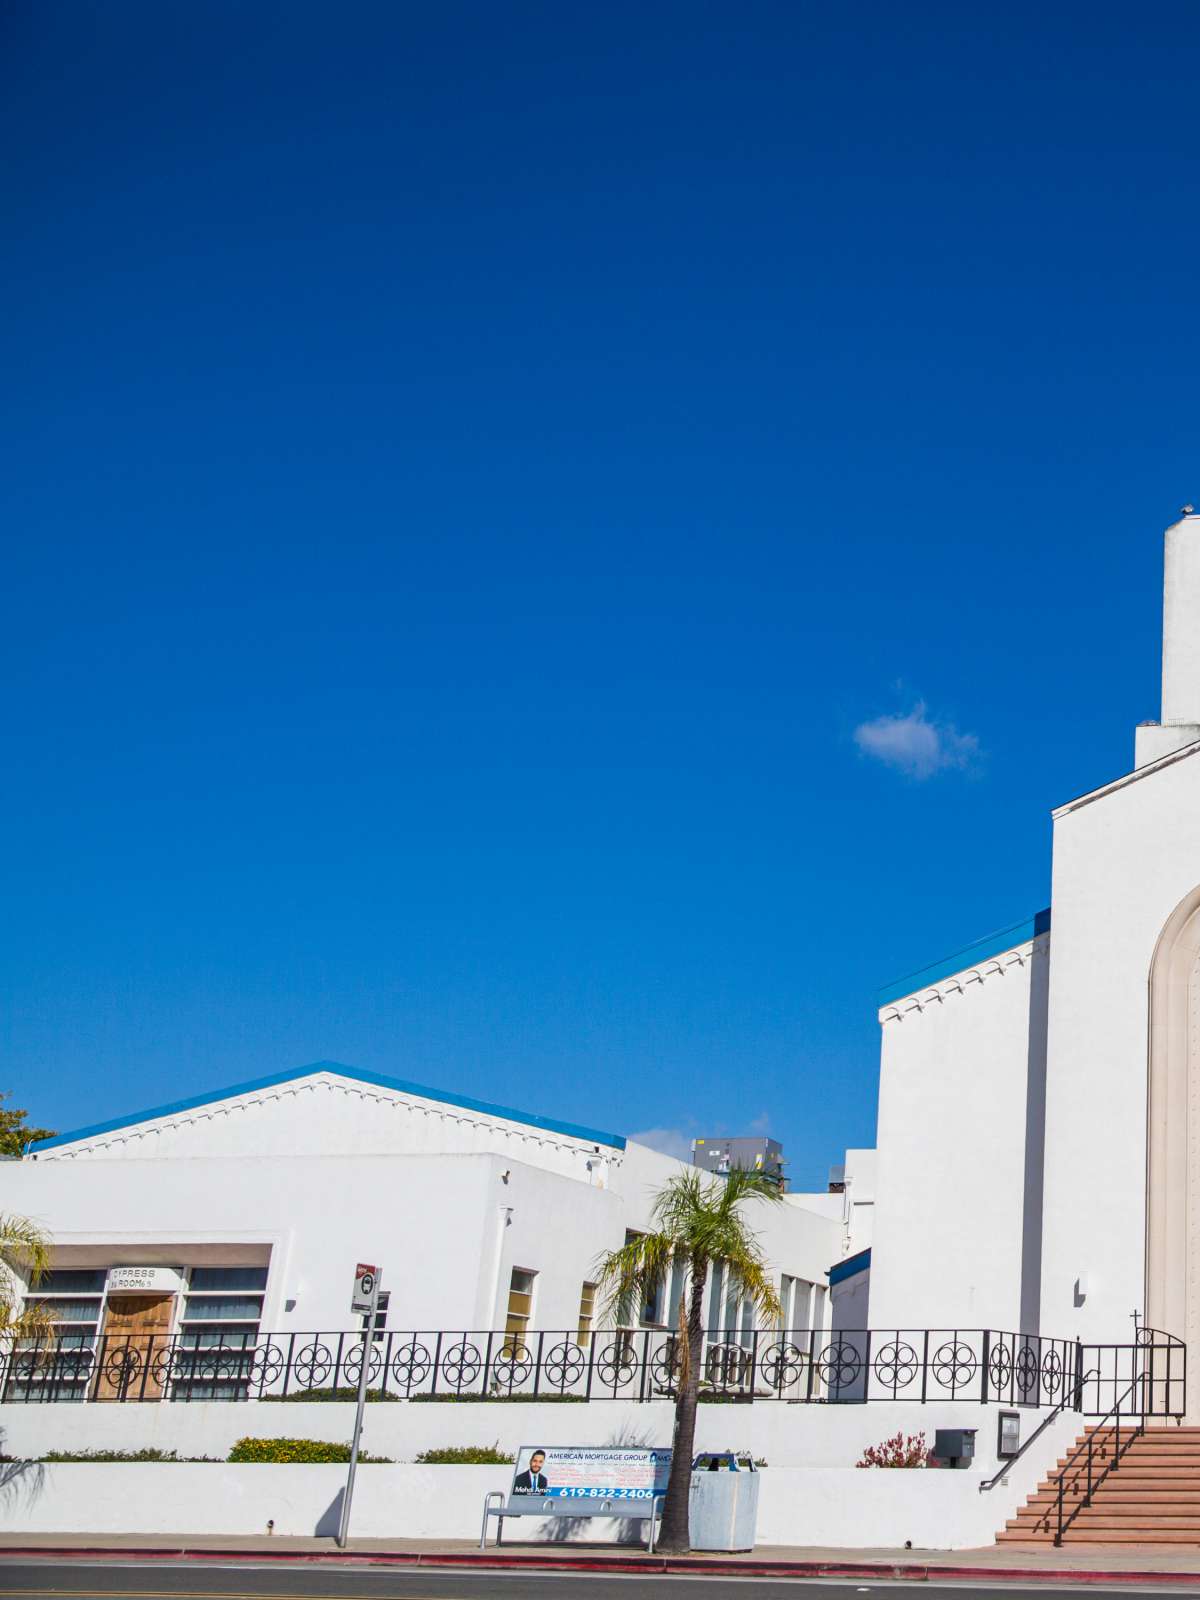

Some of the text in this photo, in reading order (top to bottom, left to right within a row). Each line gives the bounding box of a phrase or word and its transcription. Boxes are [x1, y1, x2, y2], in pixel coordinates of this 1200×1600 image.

[113, 1269, 156, 1279] CYPRESS
[119, 1279, 142, 1288] ROOM
[548, 1452, 583, 1460] AMERICAN
[585, 1453, 624, 1461] MORTGAGE
[559, 1487, 654, 1498] 619-822-2406
